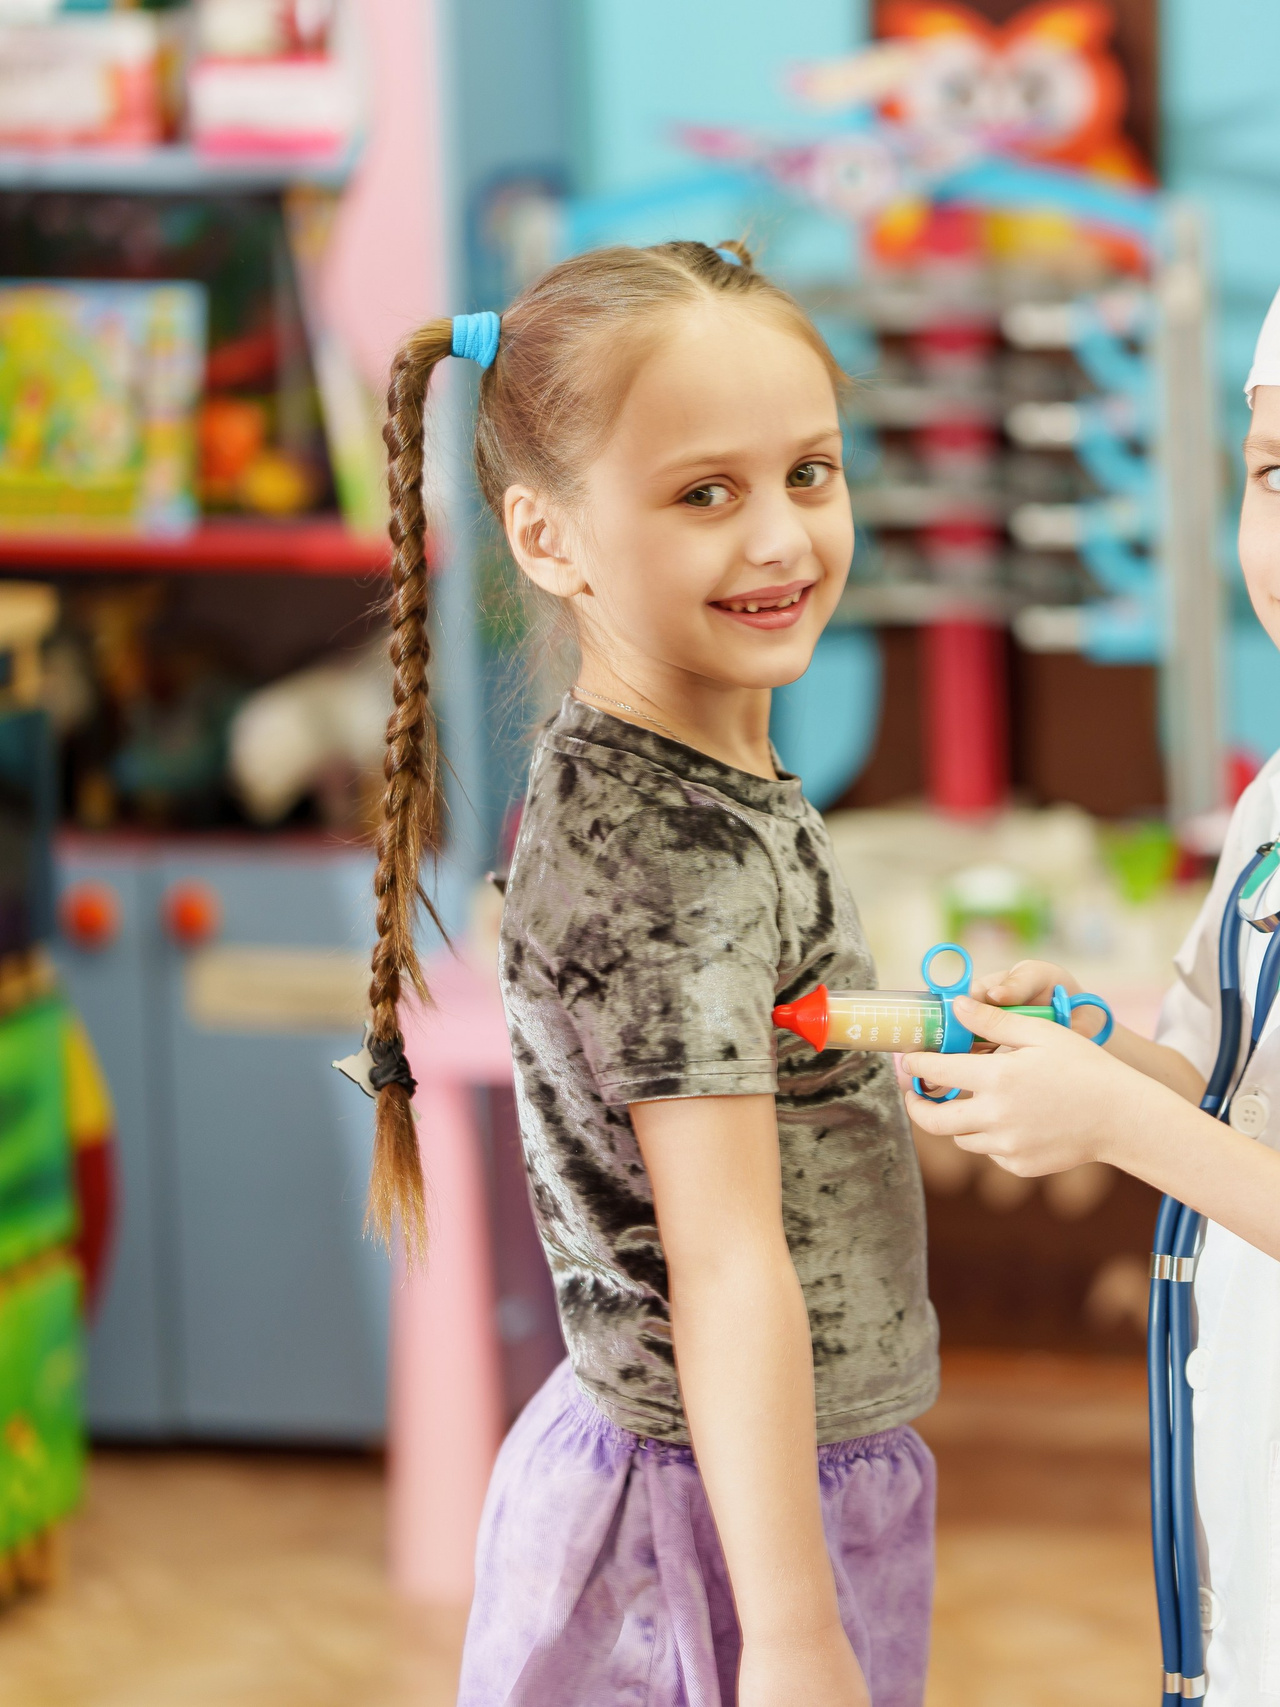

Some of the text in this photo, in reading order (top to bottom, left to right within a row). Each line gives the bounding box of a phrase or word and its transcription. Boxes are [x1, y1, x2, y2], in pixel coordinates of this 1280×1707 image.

[870, 1026, 879, 1042] 100
[892, 1026, 901, 1044] 200
[913, 1026, 923, 1044] 300
[935, 1027, 944, 1045] 400
